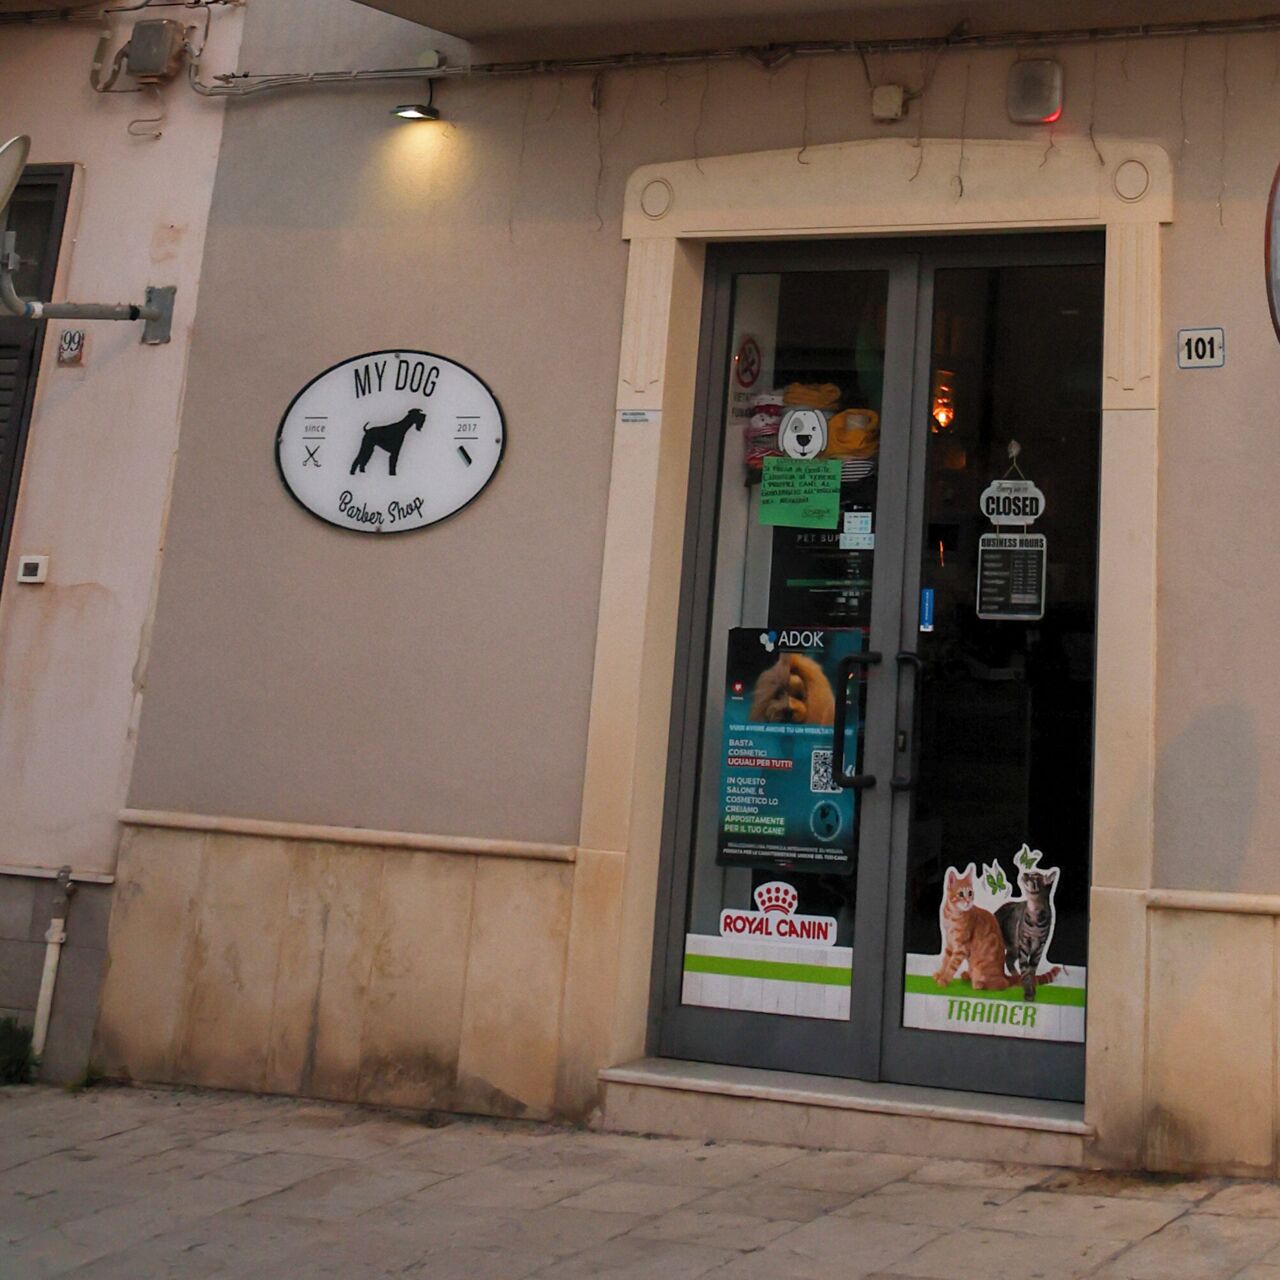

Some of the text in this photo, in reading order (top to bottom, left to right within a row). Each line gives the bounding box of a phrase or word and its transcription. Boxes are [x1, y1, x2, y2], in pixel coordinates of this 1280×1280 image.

[63, 330, 82, 351] 99
[1185, 336, 1215, 360] 101
[354, 359, 440, 399] MY DOG
[304, 423, 327, 433] since
[457, 423, 477, 432] 2017
[338, 490, 425, 525] Barber Shop
[985, 496, 1040, 516] CLOSED
[981, 538, 1044, 548] BUSINESS HOURS
[778, 630, 824, 647] ADOK
[729, 739, 754, 747] BASTA
[728, 749, 767, 757] COSMETICI
[727, 757, 756, 766] UGUALI
[756, 759, 771, 767] PER
[736, 777, 766, 786] QUESTO
[726, 796, 767, 805] COSMETICO
[725, 814, 785, 825] APPOSITAMENTE
[724, 824, 739, 833] PER
[747, 825, 761, 834] TUO
[723, 914, 829, 940] ROYAL CANIN
[947, 999, 1037, 1028] TRAINER
